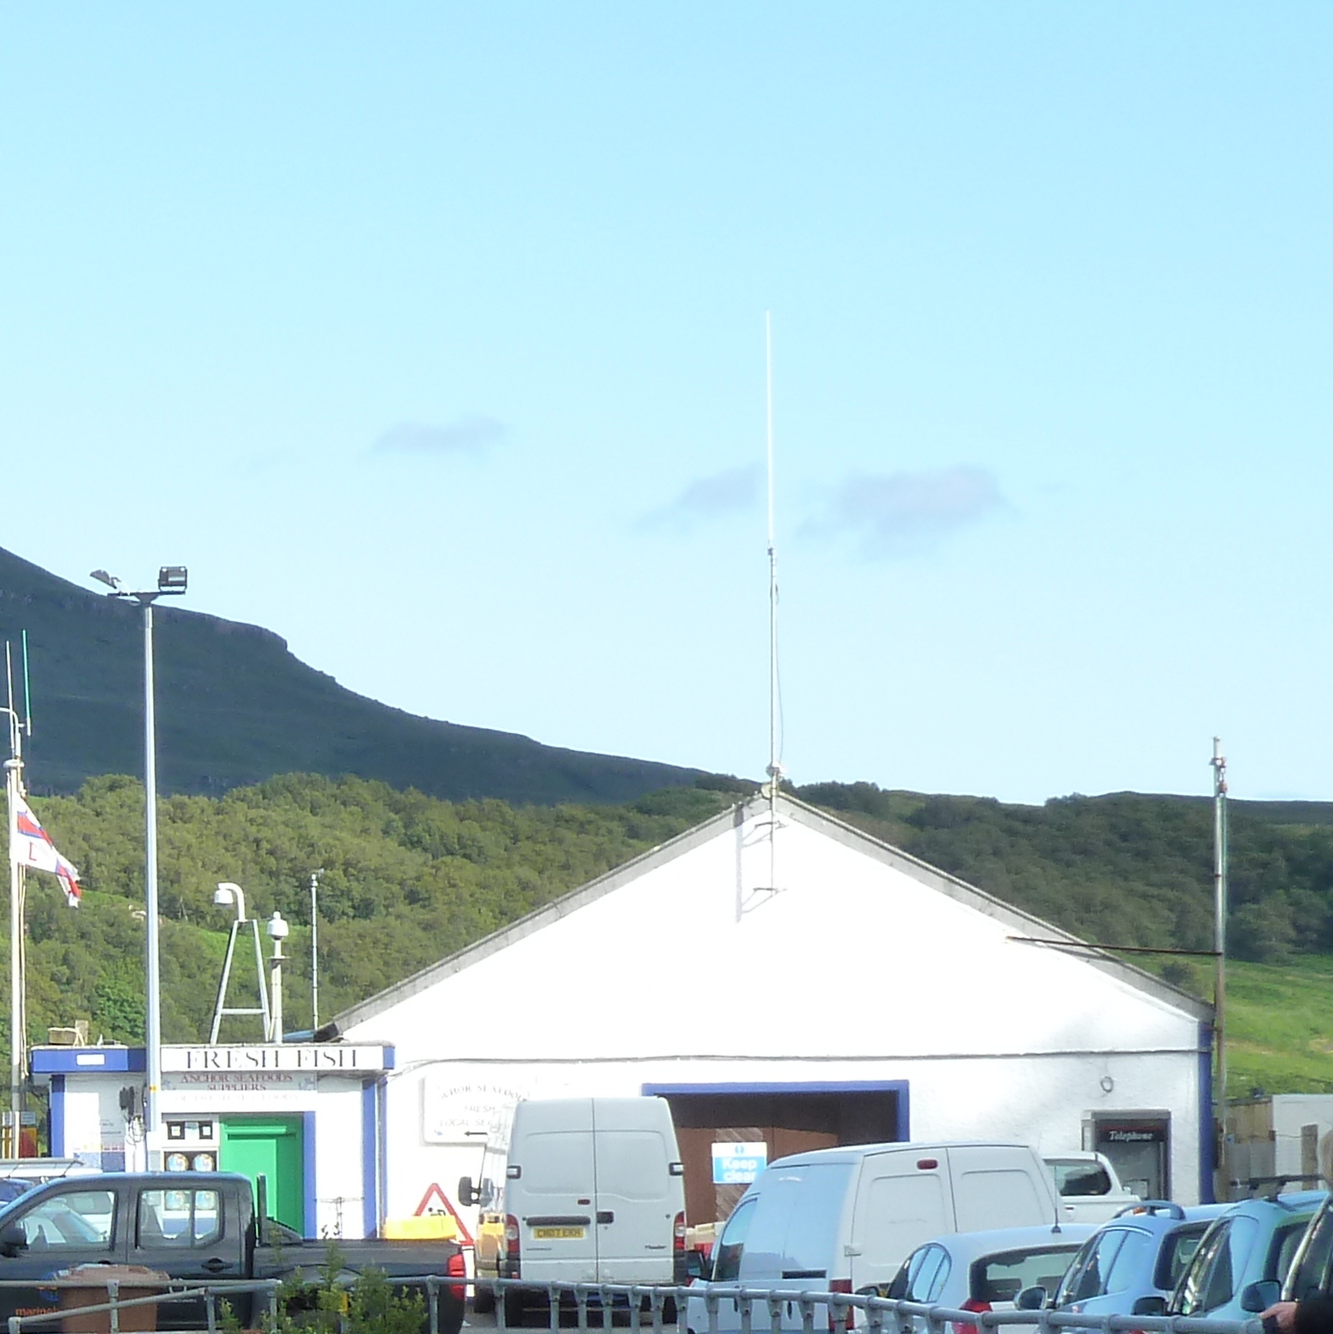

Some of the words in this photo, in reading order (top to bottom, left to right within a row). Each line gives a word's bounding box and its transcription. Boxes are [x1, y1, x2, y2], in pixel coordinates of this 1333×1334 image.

[186, 1049, 280, 1069] FRESH
[296, 1048, 358, 1068] FISH
[180, 1073, 229, 1084] ANCHOR
[232, 1072, 293, 1083] SEAFOODS
[206, 1083, 267, 1091] SUPPLIERS
[1109, 1130, 1153, 1142] Telephone
[722, 1157, 757, 1170] Keep
[723, 1169, 756, 1181] clear
